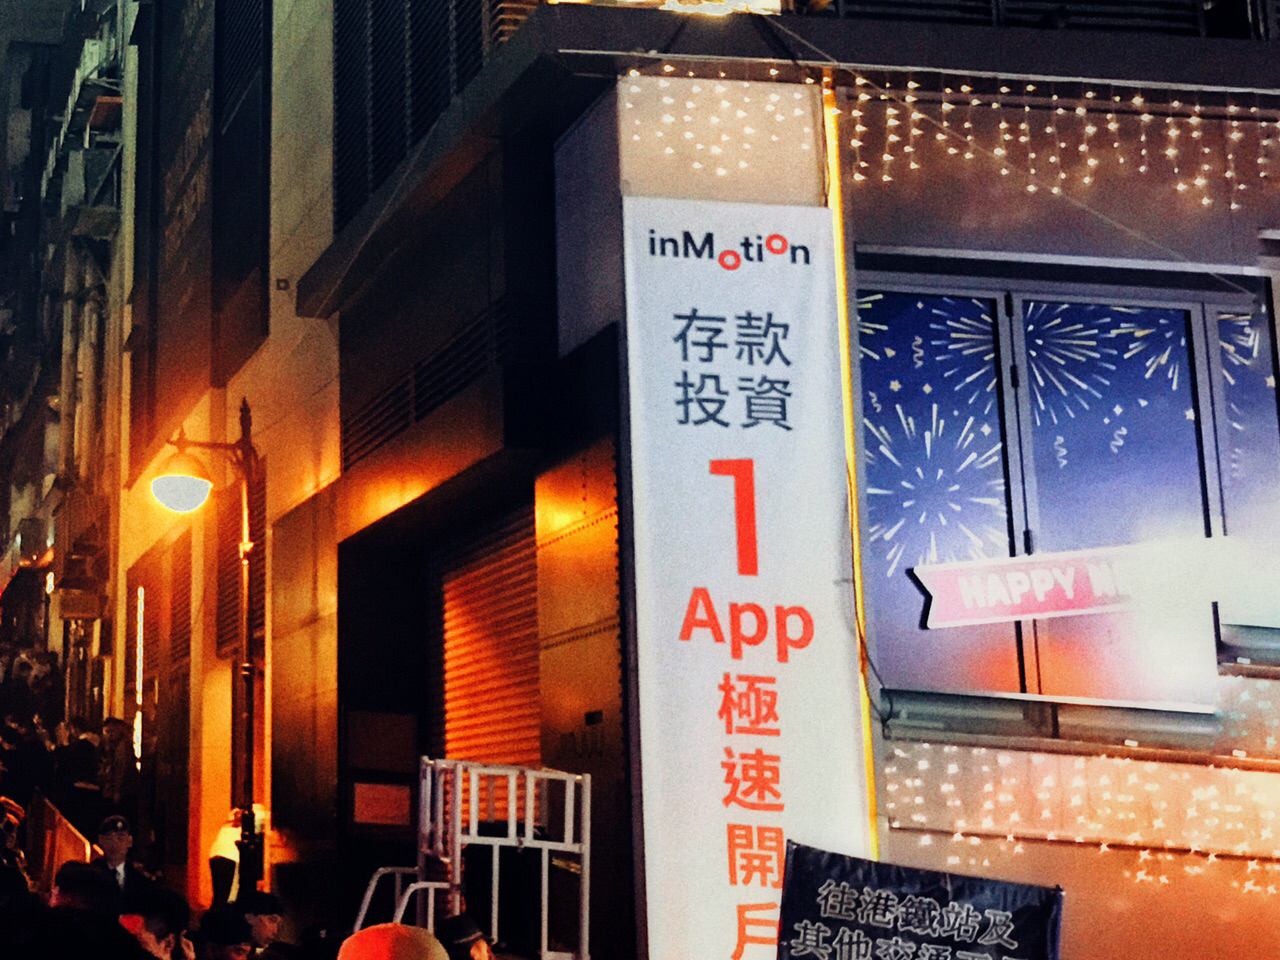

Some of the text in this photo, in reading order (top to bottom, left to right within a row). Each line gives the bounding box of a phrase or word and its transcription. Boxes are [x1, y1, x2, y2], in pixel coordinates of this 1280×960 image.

[648, 228, 811, 271] inMotion
[672, 307, 792, 367] 存款
[674, 370, 793, 431] 投資
[709, 458, 758, 577] 1
[957, 566, 1076, 610] HAPPY
[679, 587, 815, 664] App
[816, 878, 1020, 950] 往港鐵站及
